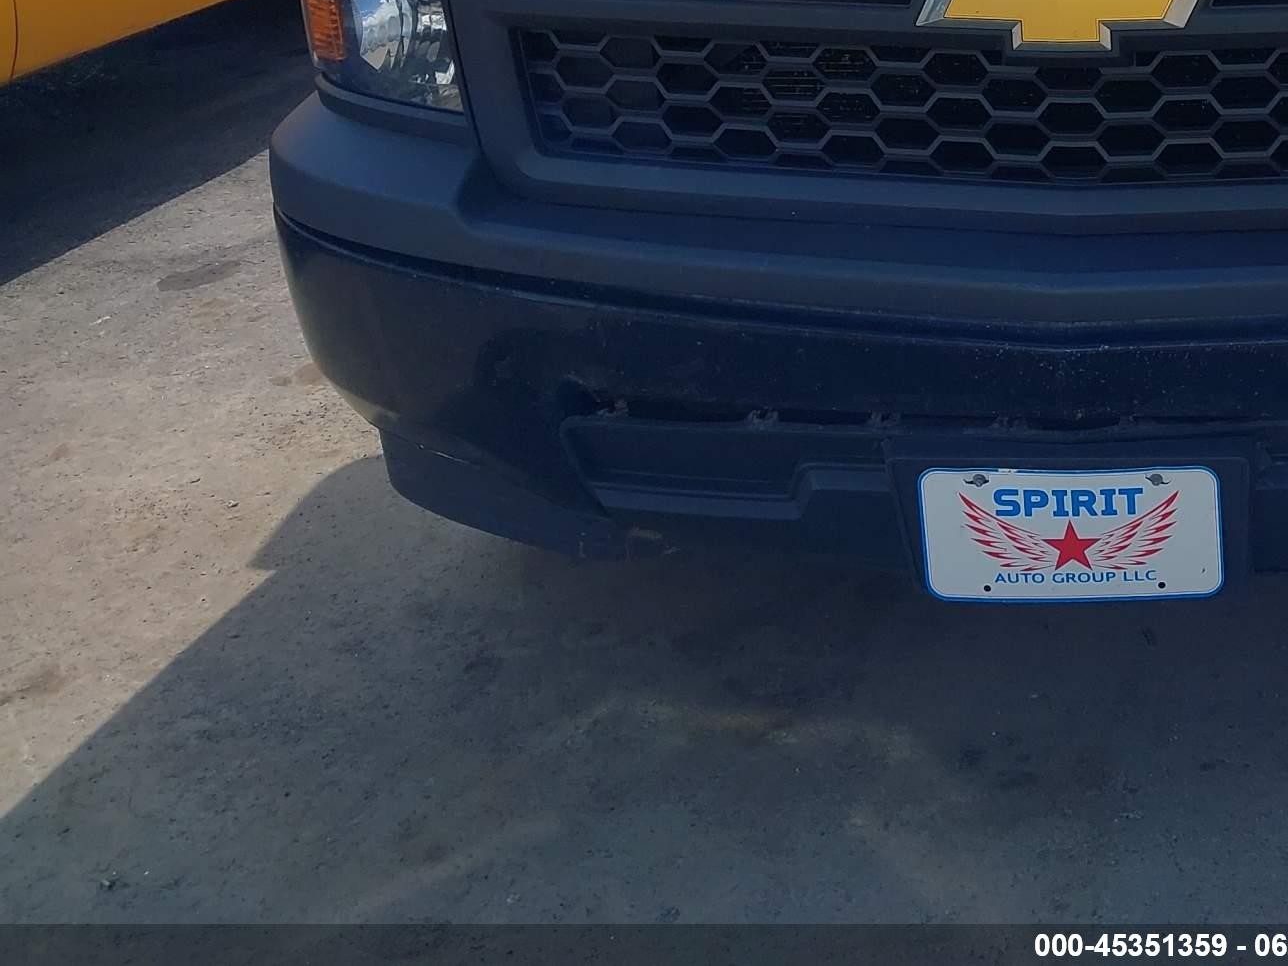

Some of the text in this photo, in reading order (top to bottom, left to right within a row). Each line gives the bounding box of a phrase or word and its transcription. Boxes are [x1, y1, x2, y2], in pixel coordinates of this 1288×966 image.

[993, 487, 1143, 517] SPIRIT
[994, 570, 1157, 584] AUTO GROUP LLC
